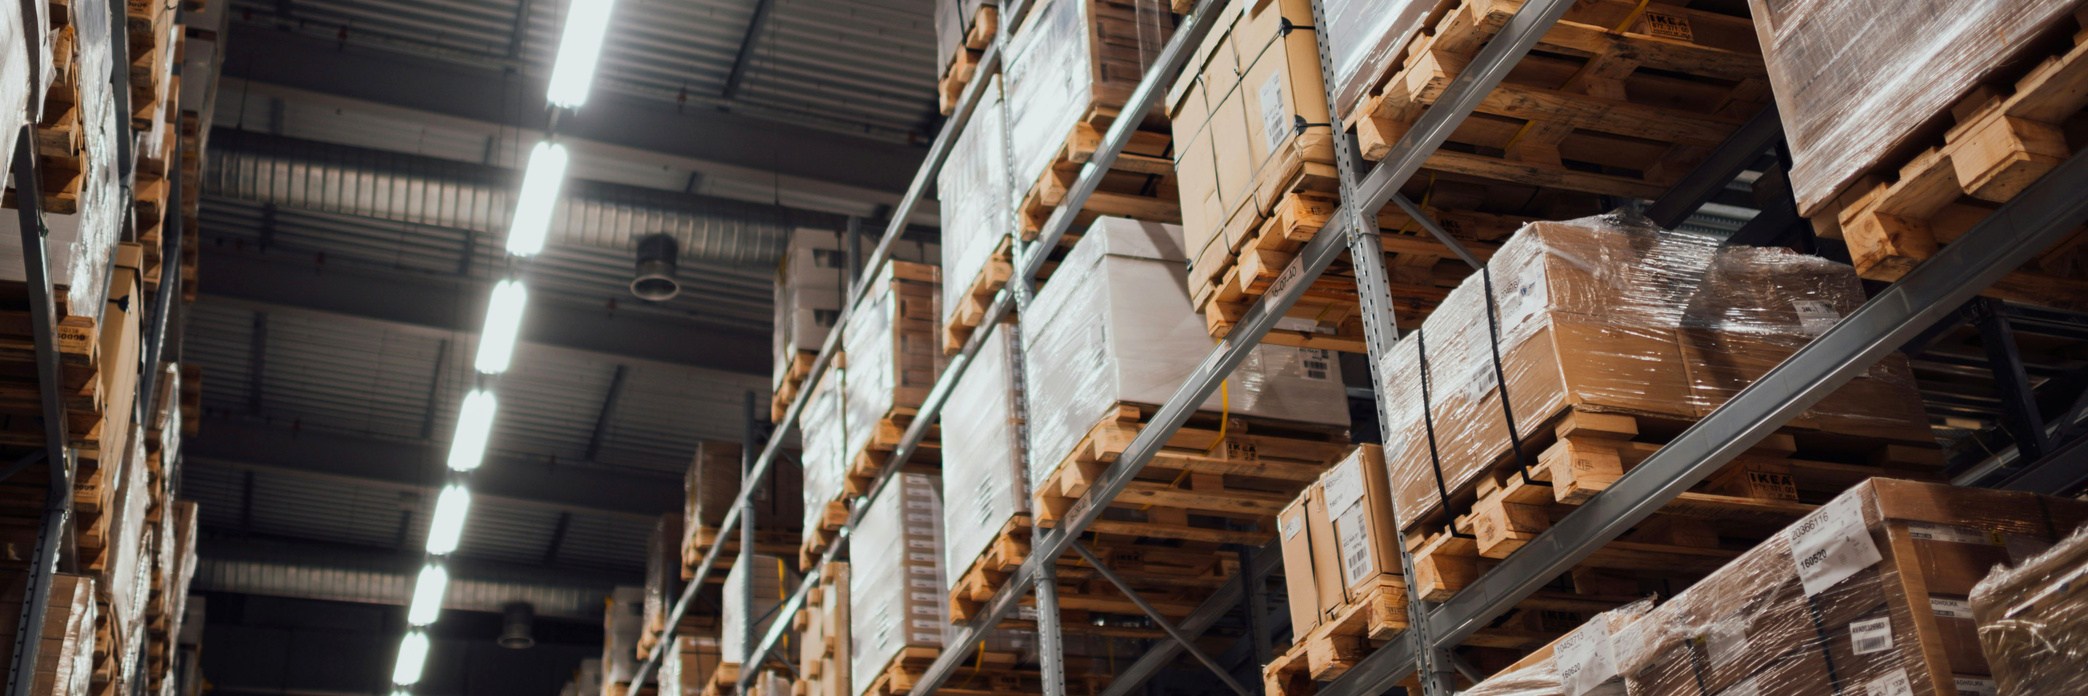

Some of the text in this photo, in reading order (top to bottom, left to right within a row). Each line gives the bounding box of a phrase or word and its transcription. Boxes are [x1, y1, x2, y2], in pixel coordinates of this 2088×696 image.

[1649, 14, 1687, 27] IKEA
[1750, 472, 1792, 485] IKEA
[1791, 511, 1829, 541] 20366116
[1800, 548, 1827, 570] 160520
[1556, 631, 1584, 654] 10452713
